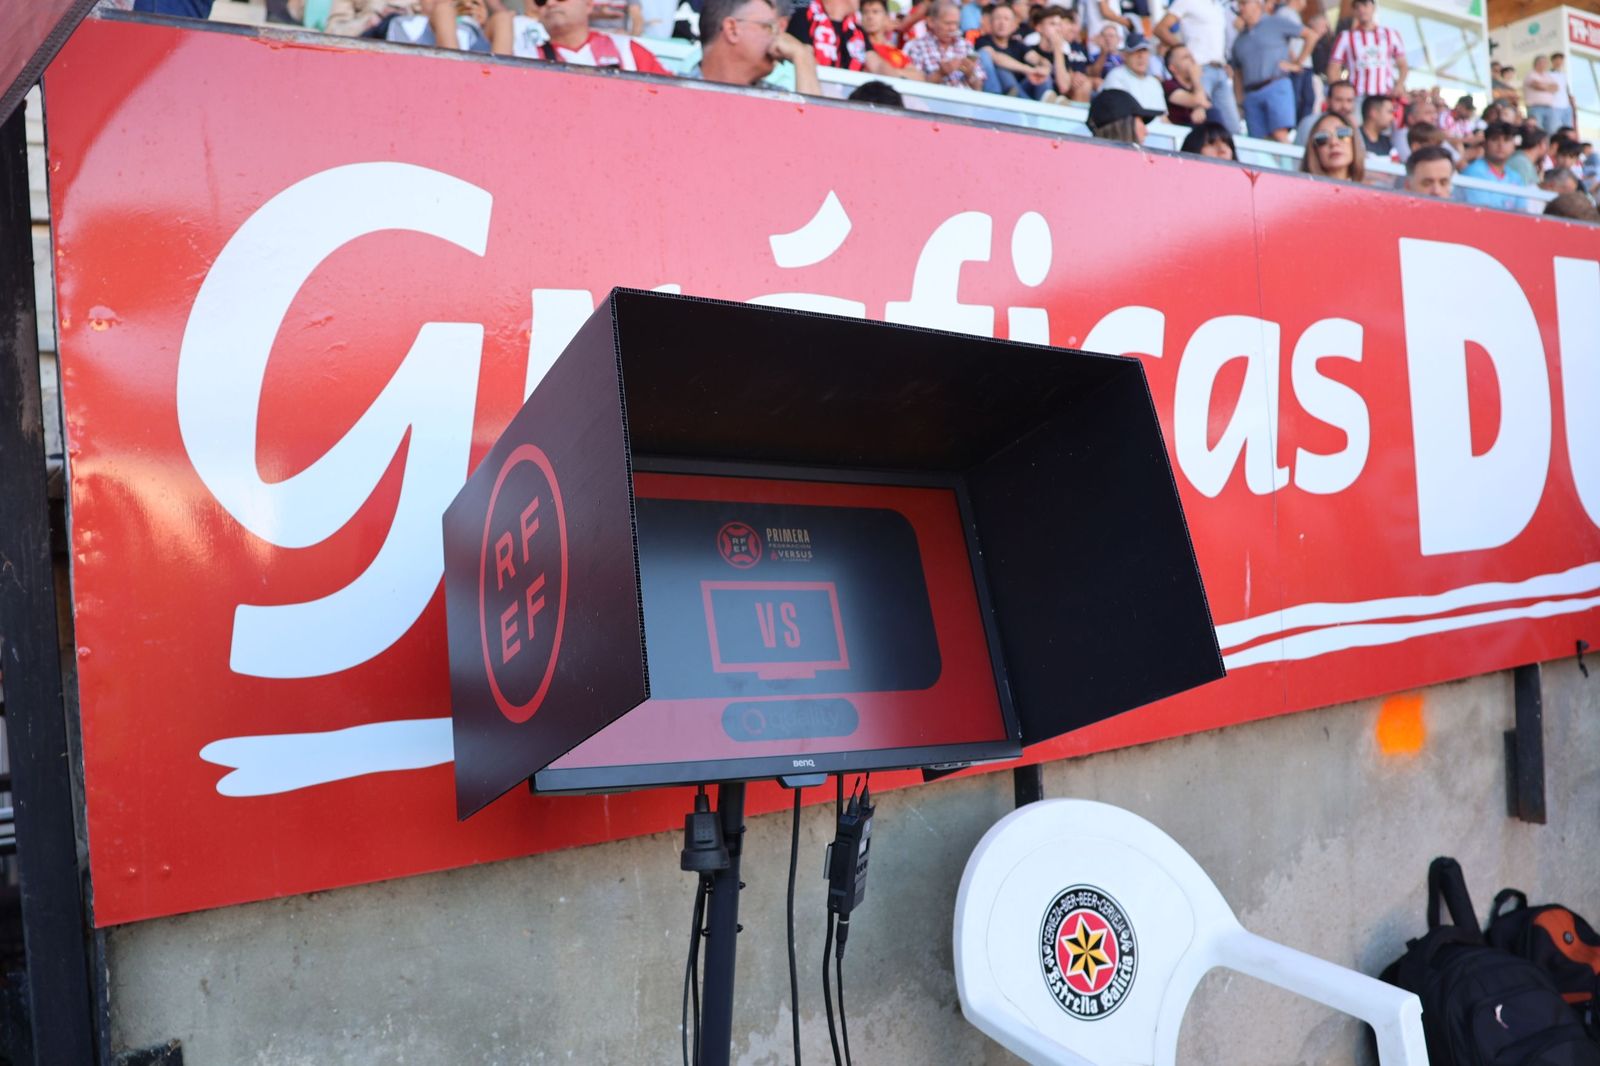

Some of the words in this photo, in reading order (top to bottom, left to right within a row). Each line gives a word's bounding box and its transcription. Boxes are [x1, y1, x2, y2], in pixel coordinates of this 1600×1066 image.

[766, 527, 810, 544] PRIMERA
[777, 550, 814, 559] VERSUS
[755, 602, 800, 648] VS
[1046, 965, 1099, 1015] Estrella
[1100, 955, 1135, 1011] Galicia
